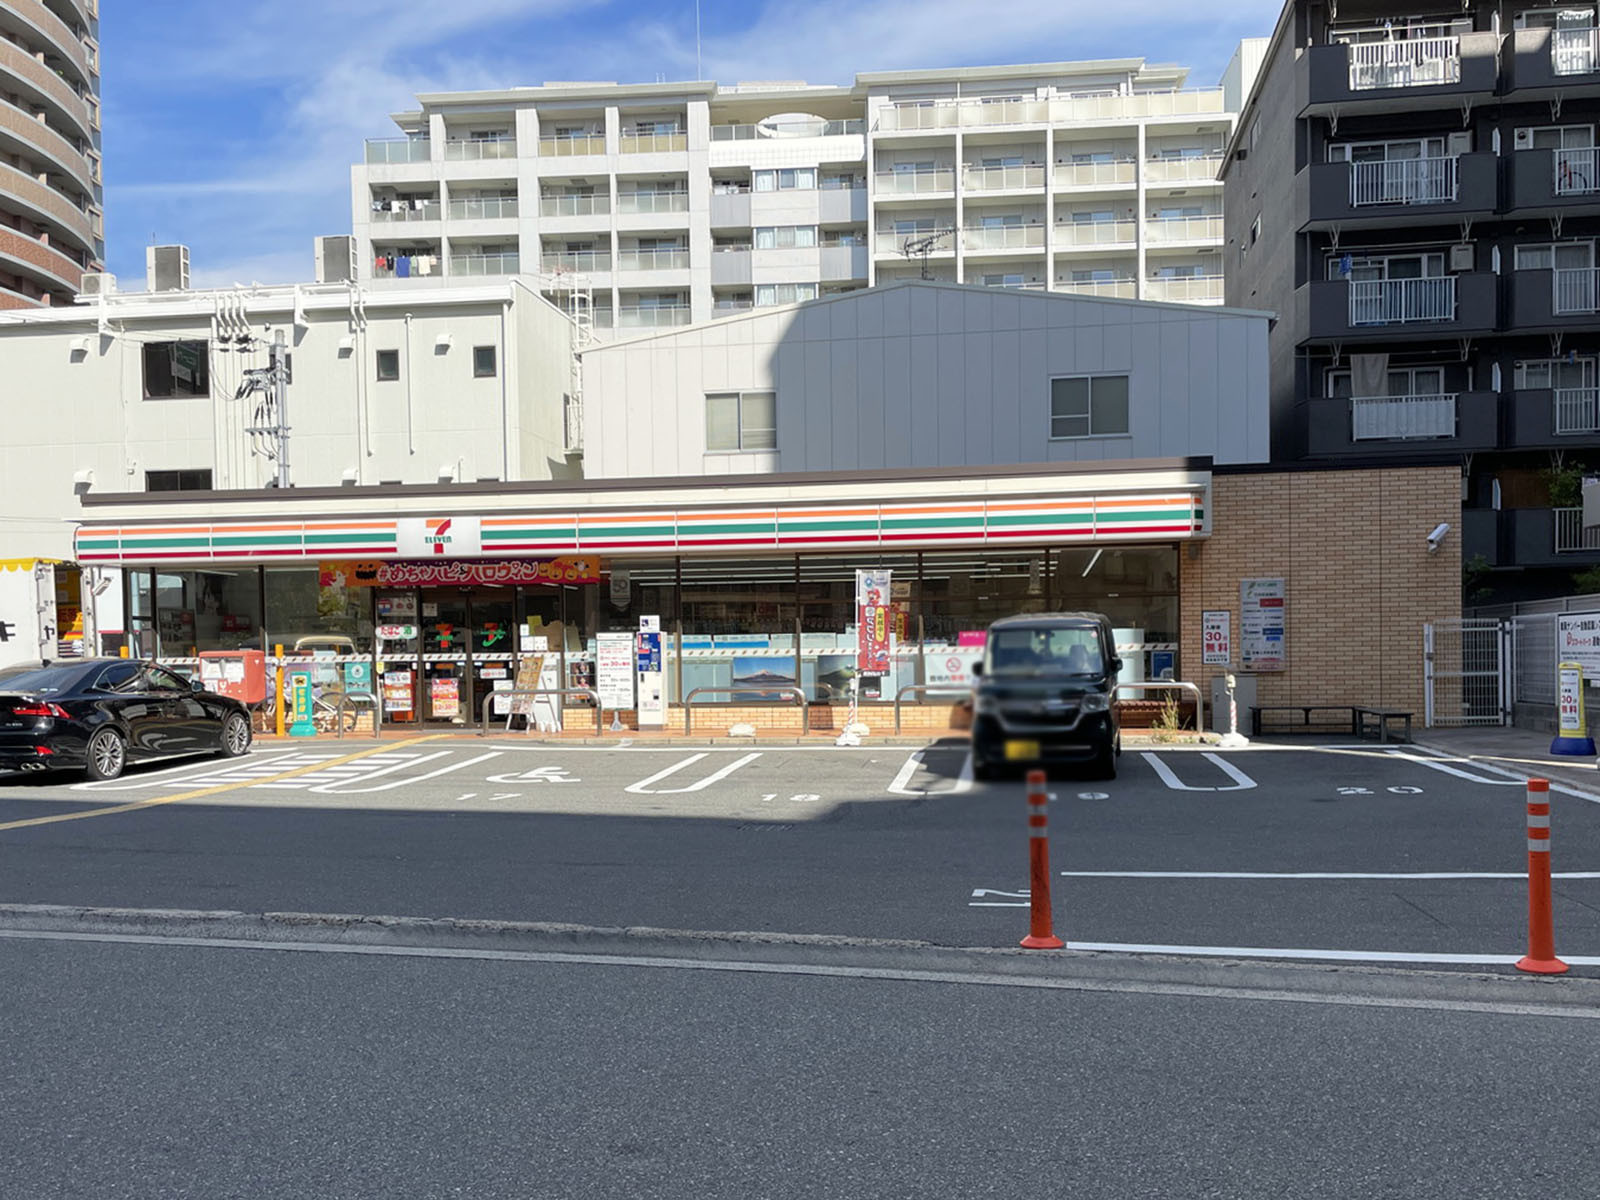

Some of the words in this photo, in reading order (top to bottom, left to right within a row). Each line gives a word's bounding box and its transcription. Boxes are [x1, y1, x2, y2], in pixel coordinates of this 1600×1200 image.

[425, 518, 452, 554] 7
[380, 626, 400, 636] たばこ
